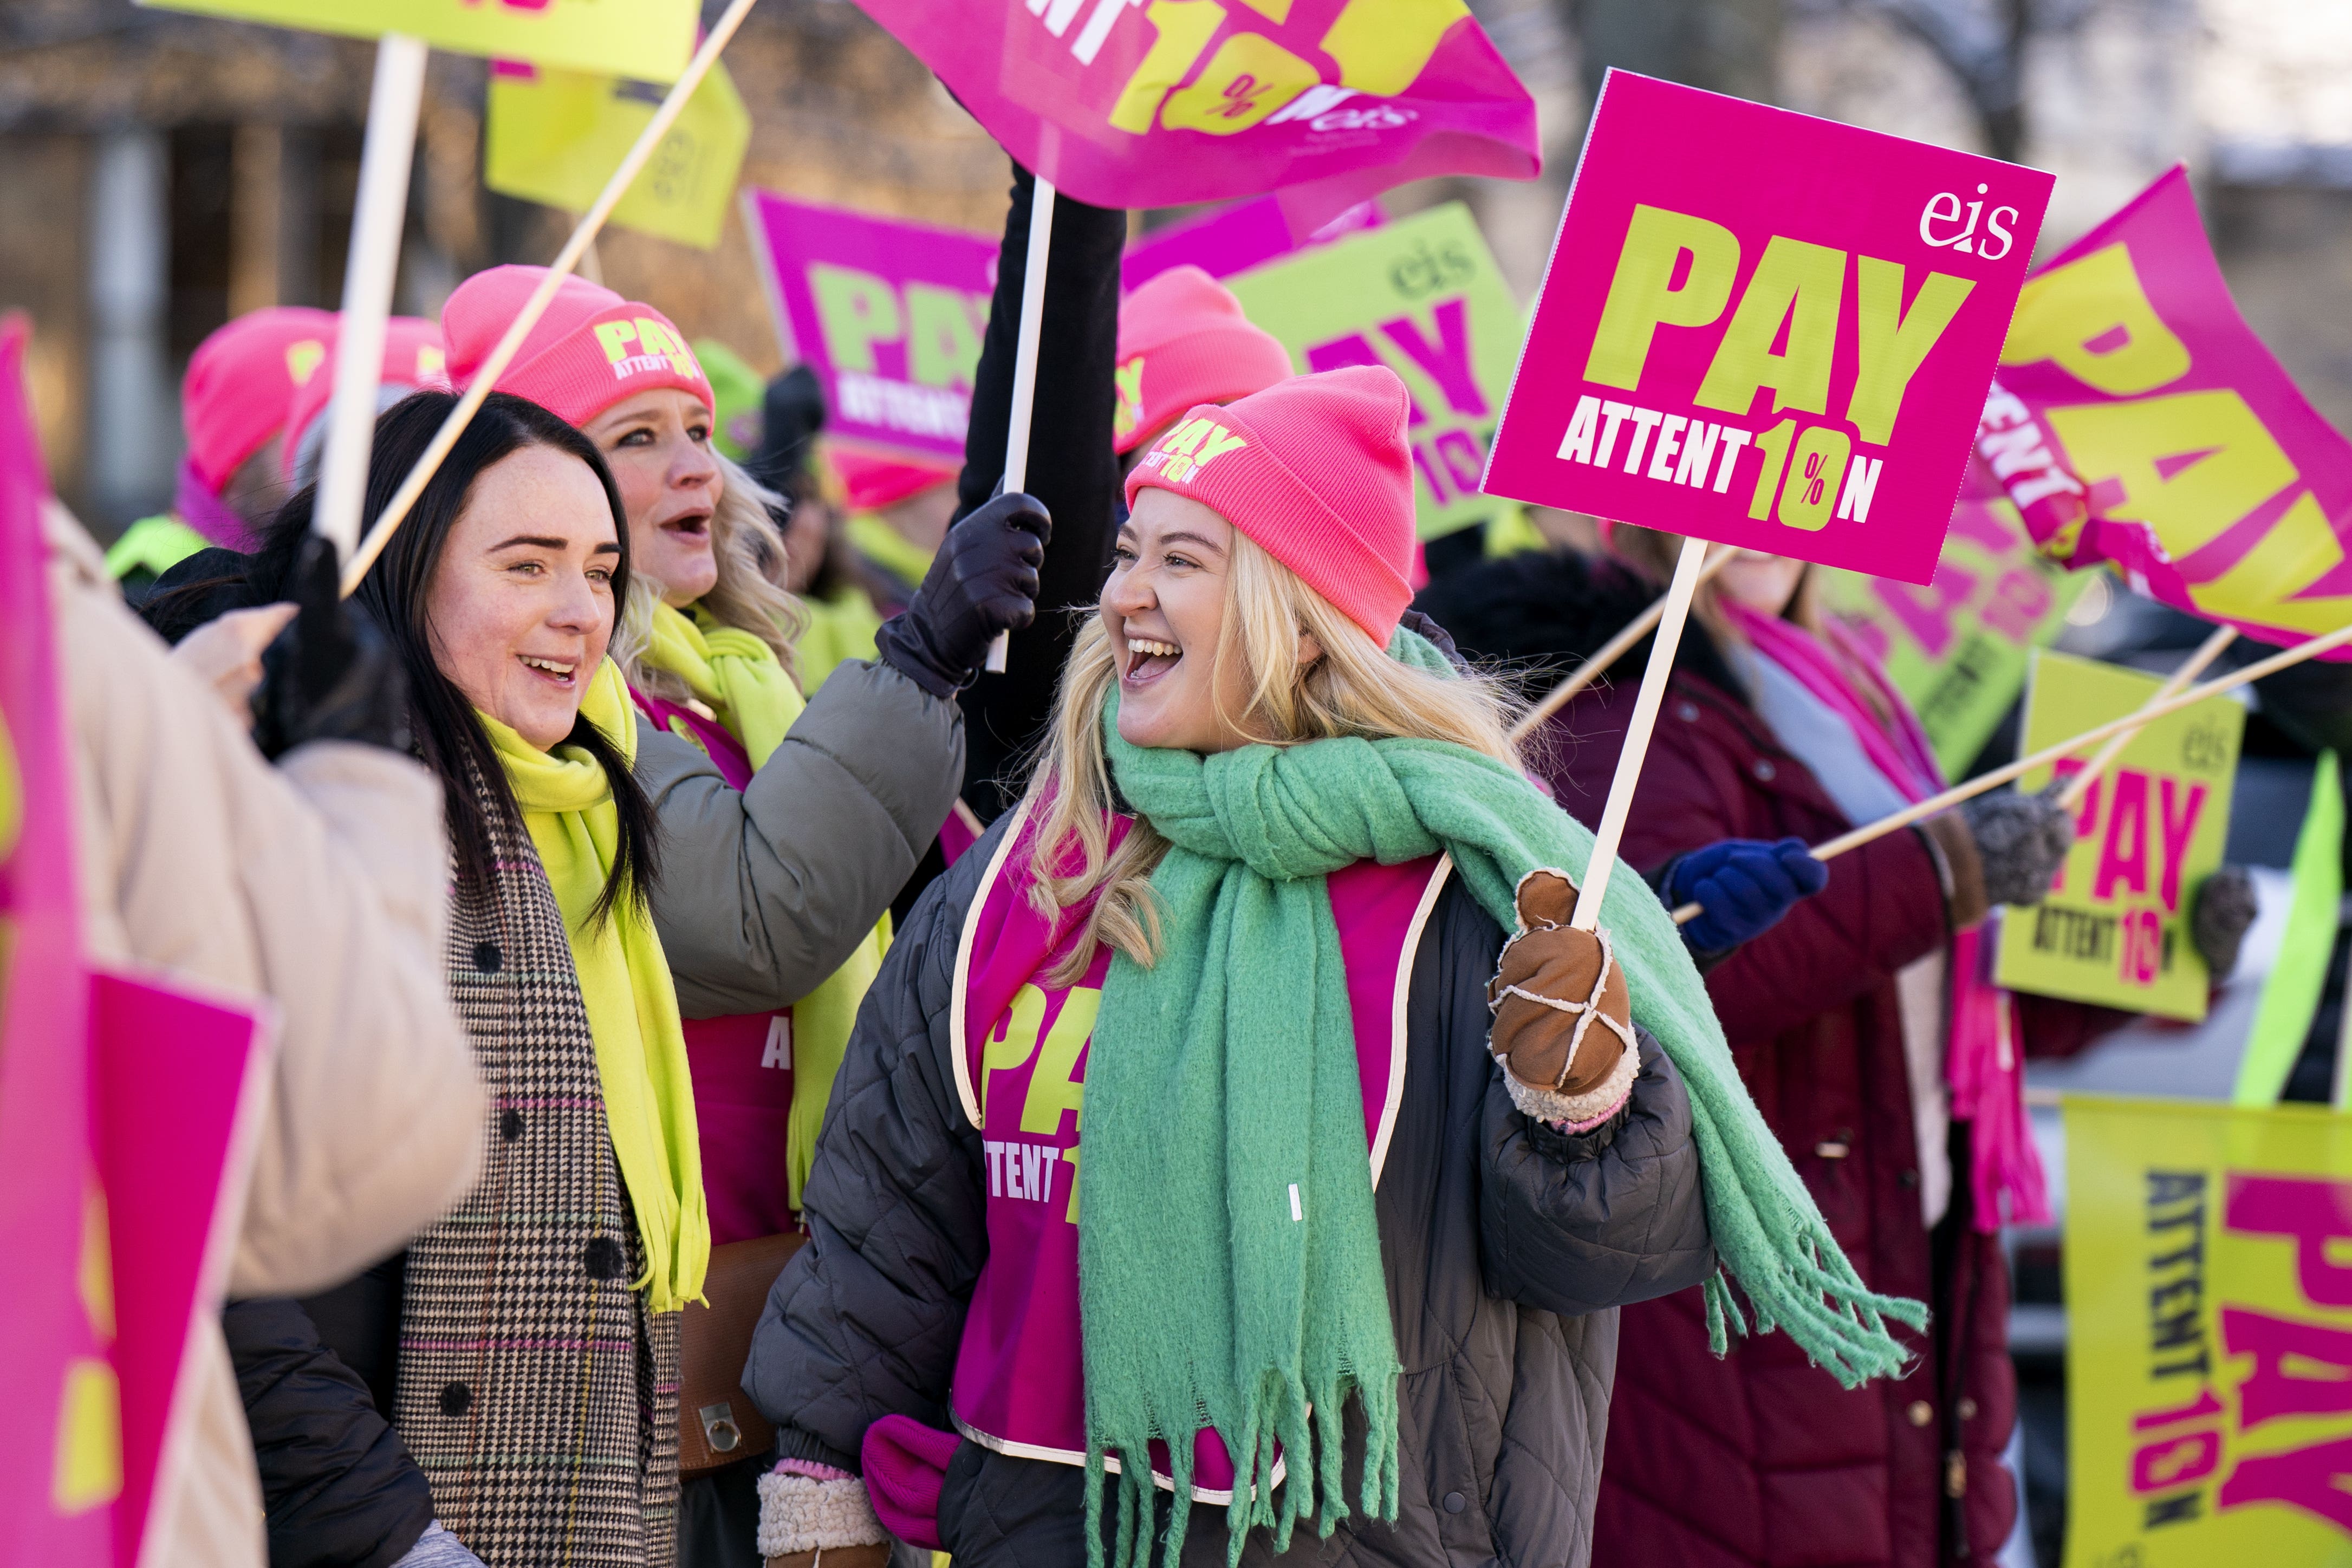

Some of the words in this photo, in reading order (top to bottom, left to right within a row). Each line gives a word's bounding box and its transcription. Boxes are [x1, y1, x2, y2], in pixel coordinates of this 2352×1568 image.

[1388, 238, 1478, 299] eis
[1919, 183, 2019, 261] eis
[593, 316, 693, 365] PAY
[806, 261, 995, 390] PA
[1582, 203, 1978, 447] PAY
[981, 982, 1102, 1136] PA
